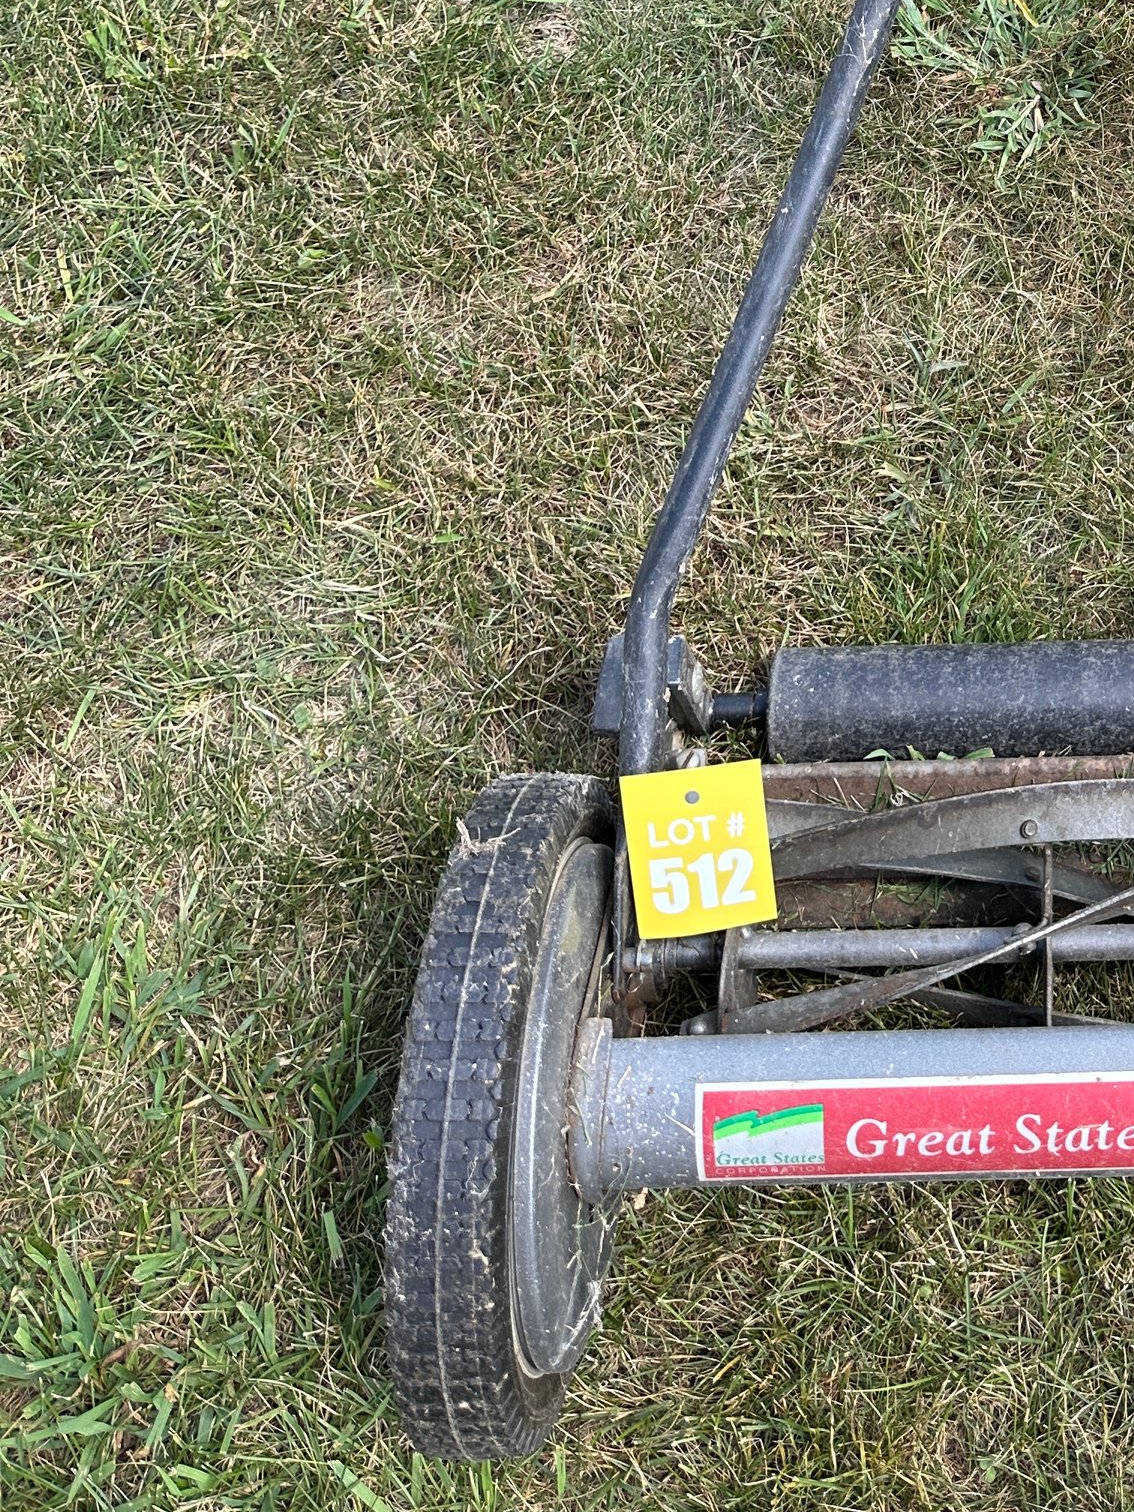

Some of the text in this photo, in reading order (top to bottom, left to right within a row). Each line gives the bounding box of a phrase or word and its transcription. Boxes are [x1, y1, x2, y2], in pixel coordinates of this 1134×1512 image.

[647, 812, 746, 848] LOT #
[648, 848, 757, 915] 512
[846, 1118, 996, 1158] Great
[715, 1165, 826, 1175] CORPORATION
[716, 1152, 824, 1165] Great States
